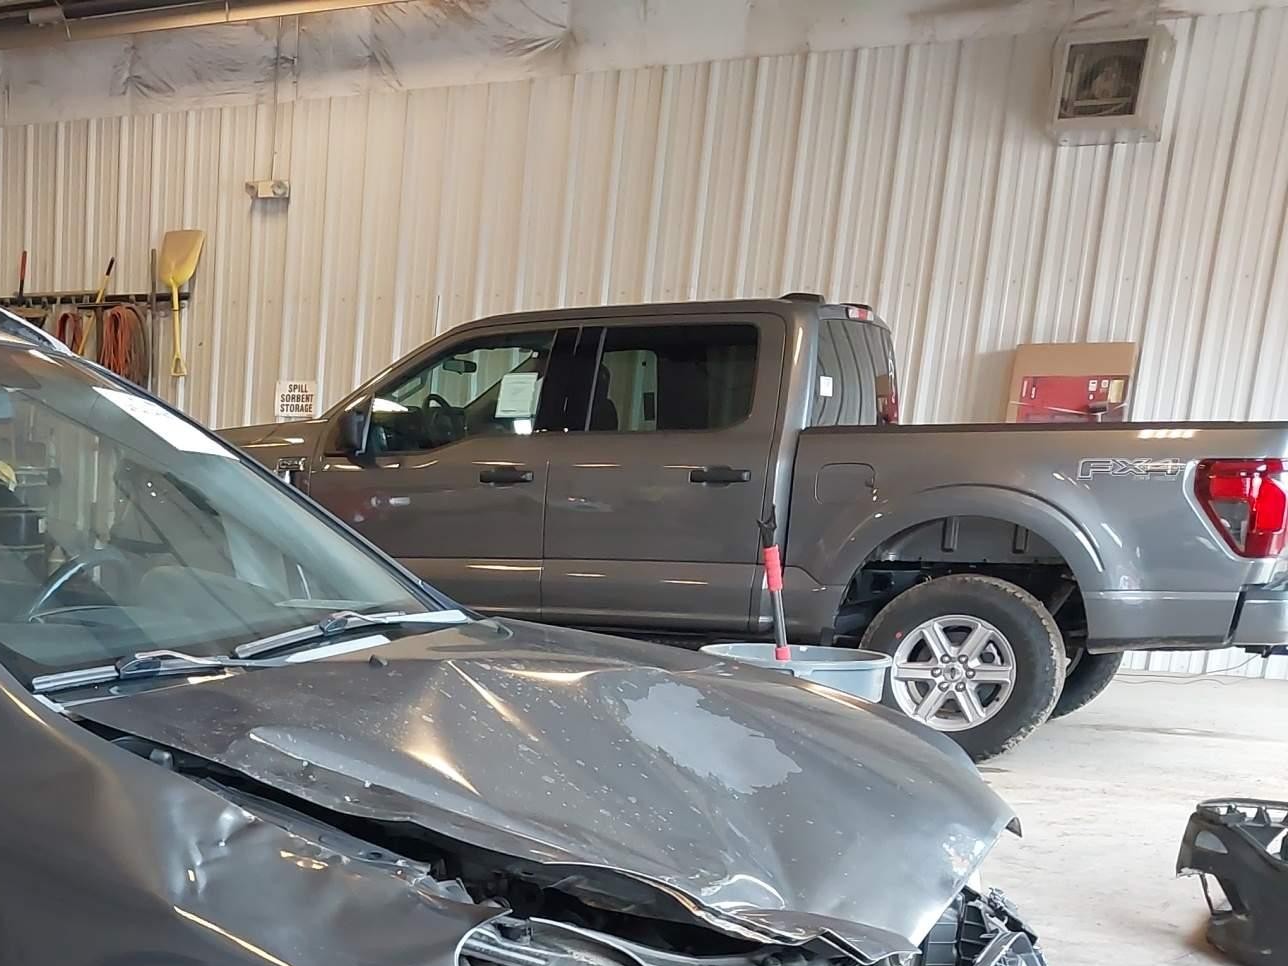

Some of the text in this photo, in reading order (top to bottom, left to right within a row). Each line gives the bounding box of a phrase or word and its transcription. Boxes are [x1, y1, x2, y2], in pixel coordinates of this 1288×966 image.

[288, 384, 308, 393] SPILL
[280, 394, 314, 403] SORBENT
[280, 404, 313, 413] STORAGE
[1077, 458, 1180, 480] FX4
